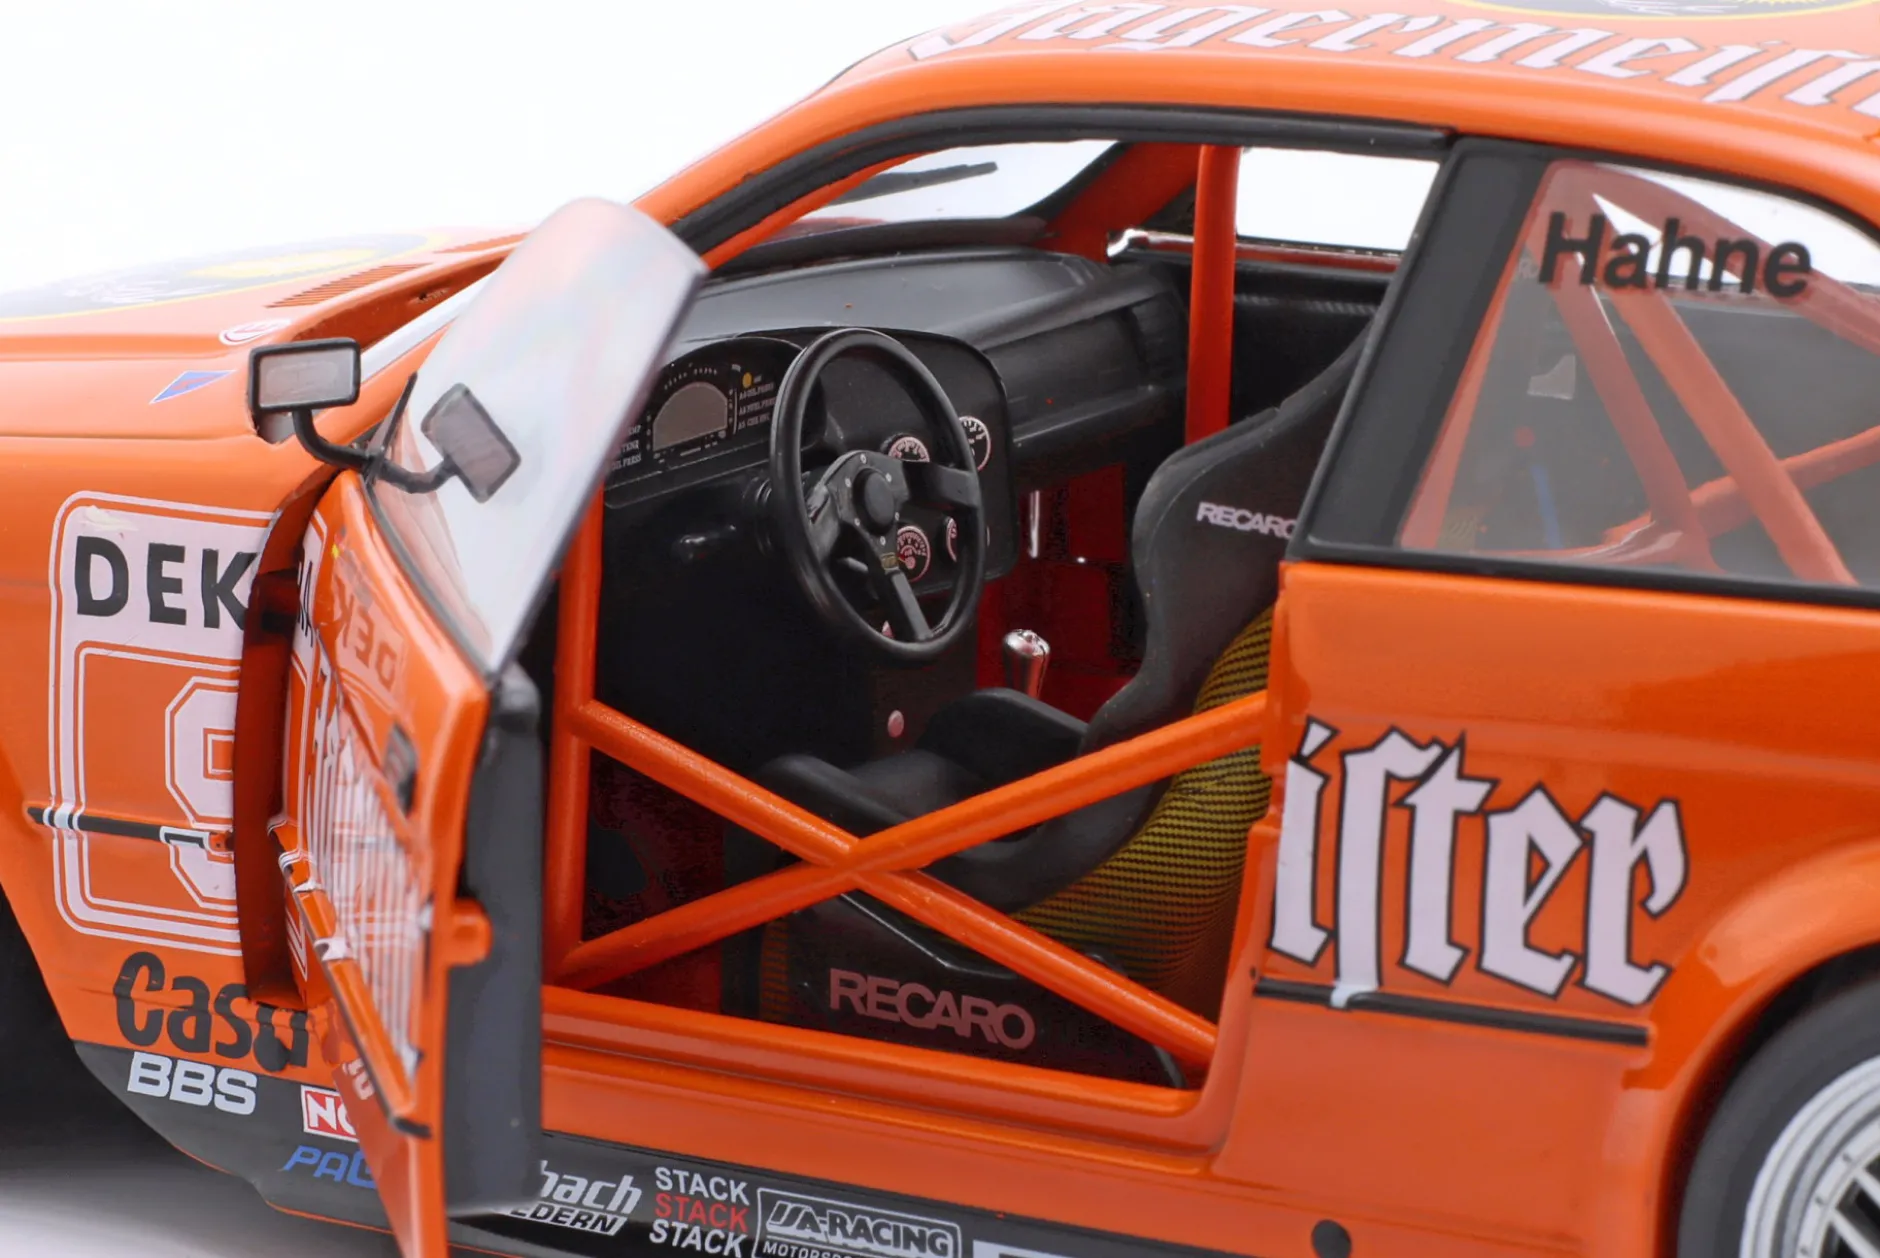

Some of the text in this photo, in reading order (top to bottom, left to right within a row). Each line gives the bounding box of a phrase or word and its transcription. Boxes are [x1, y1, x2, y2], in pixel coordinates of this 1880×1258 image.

[1539, 211, 1811, 298] Hahne
[829, 967, 1037, 1050] RECARO
[127, 1051, 258, 1116] BBS
[655, 1166, 750, 1206] STACK
[655, 1192, 749, 1233] STACK
[649, 1219, 748, 1258] STACK
